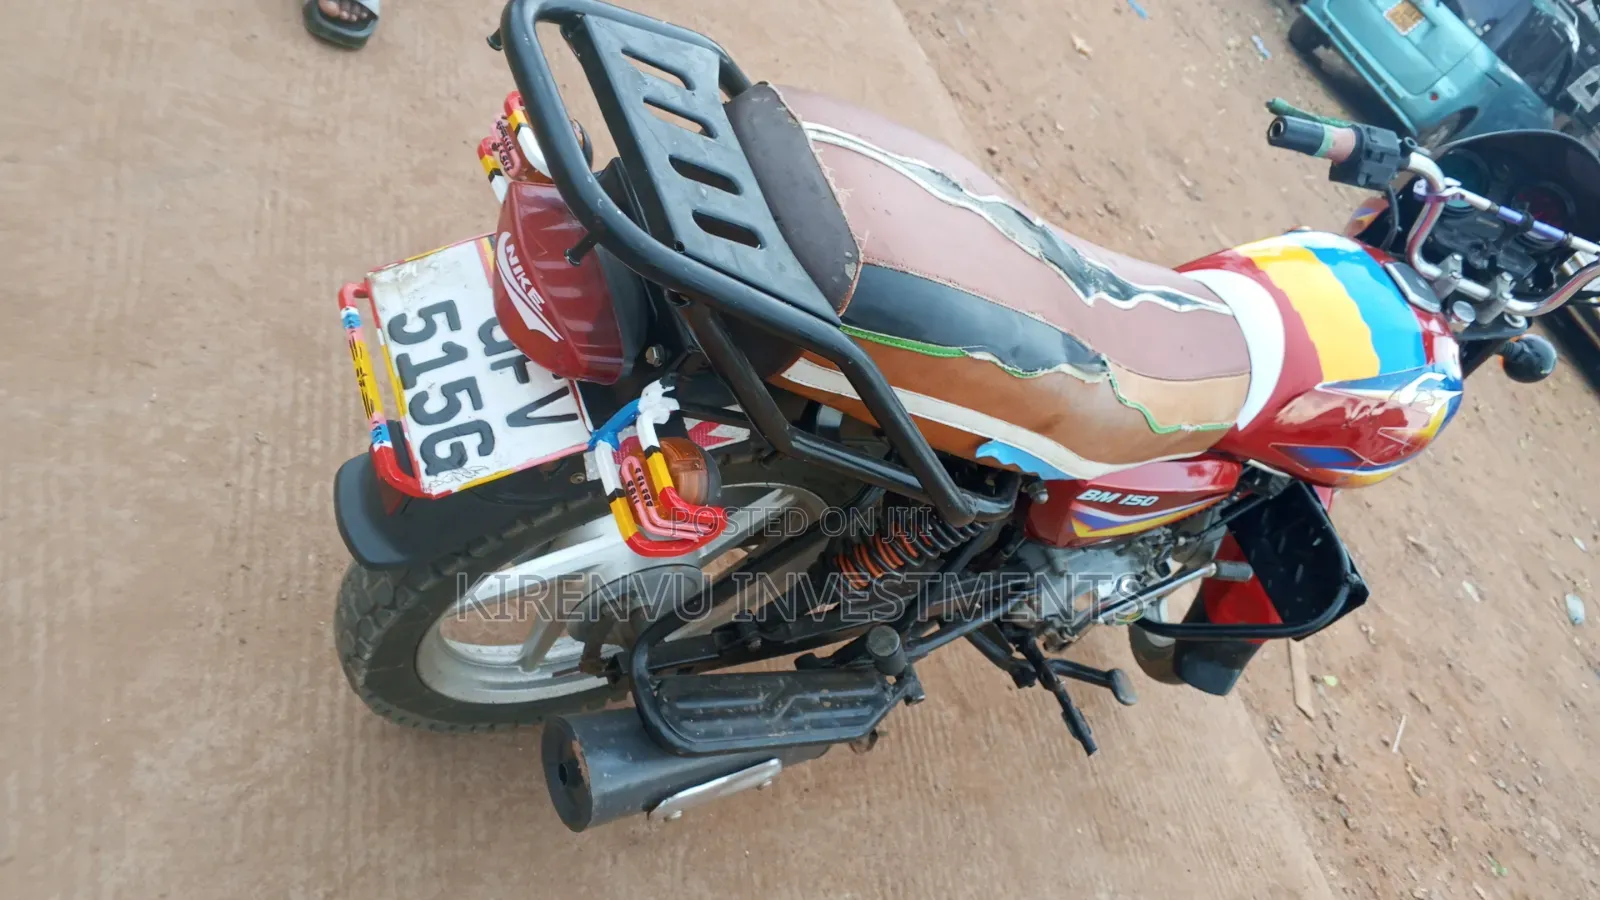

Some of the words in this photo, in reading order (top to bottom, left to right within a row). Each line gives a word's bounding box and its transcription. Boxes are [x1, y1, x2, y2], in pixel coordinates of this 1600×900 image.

[506, 243, 546, 312] NIKE
[387, 299, 495, 476] 515G
[1076, 488, 1122, 504] BM
[1117, 494, 1160, 507] 150
